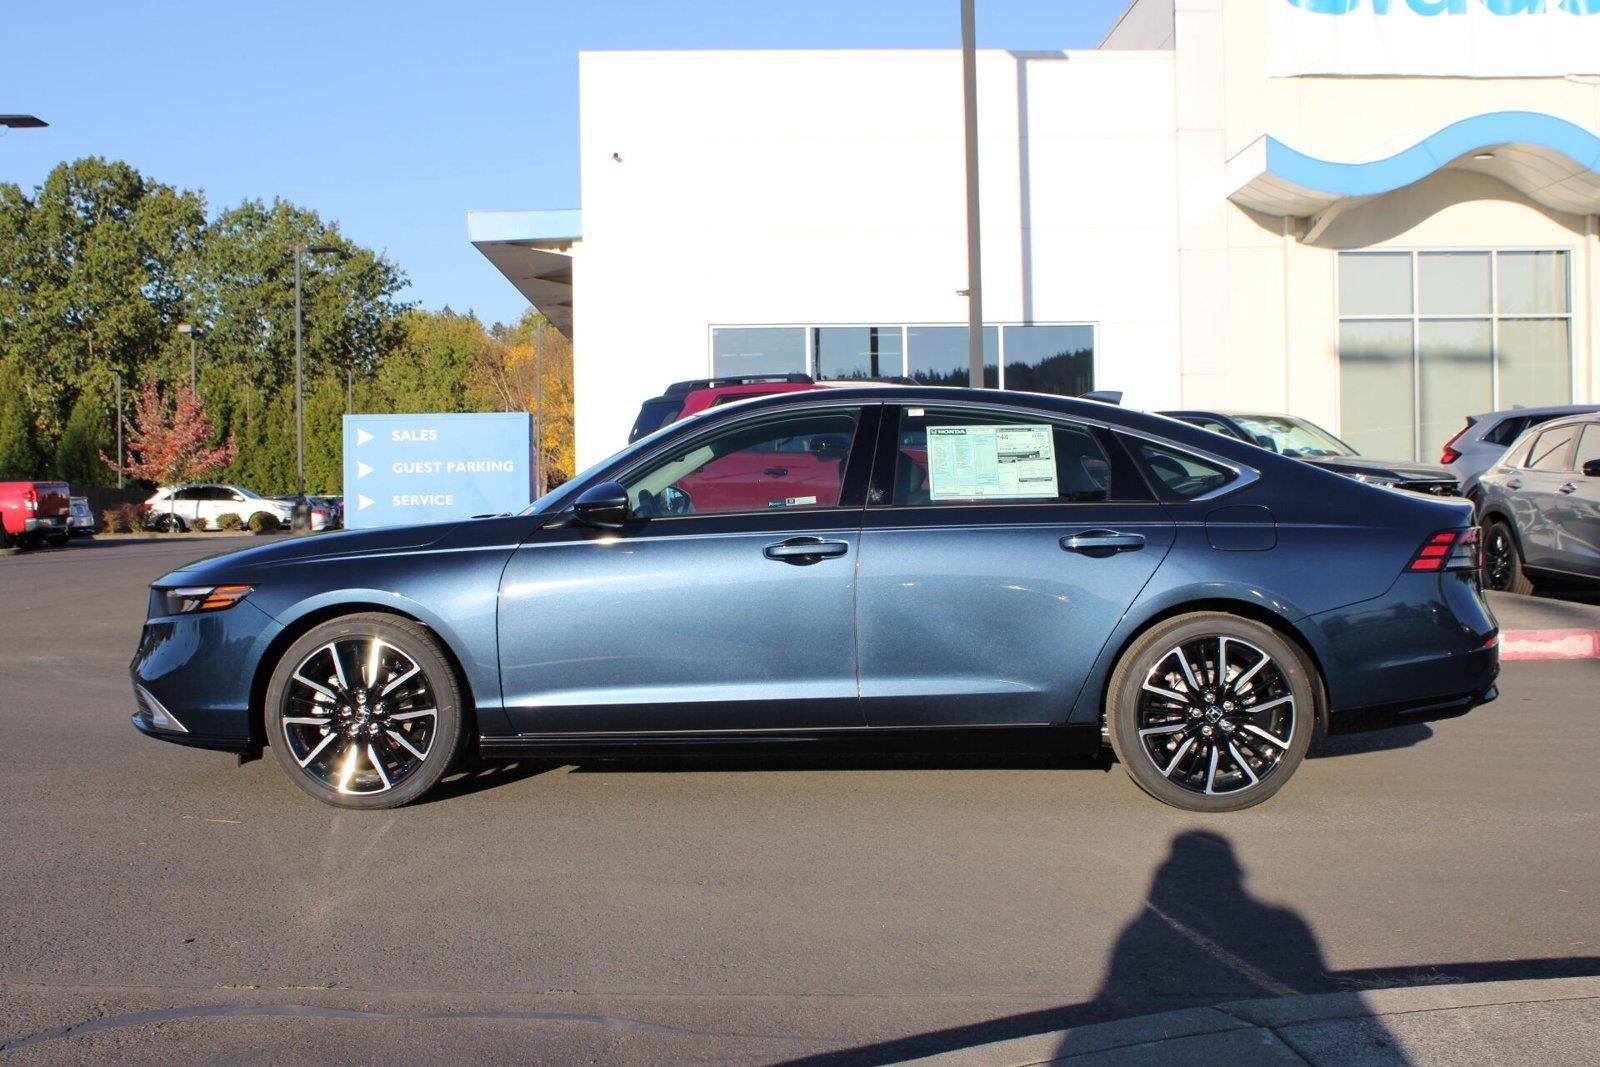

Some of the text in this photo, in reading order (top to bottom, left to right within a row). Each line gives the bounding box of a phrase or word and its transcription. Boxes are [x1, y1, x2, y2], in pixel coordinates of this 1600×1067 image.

[391, 429, 438, 441] SALES
[392, 461, 514, 474] GUEST PARKING
[393, 495, 454, 506] SERVICE
